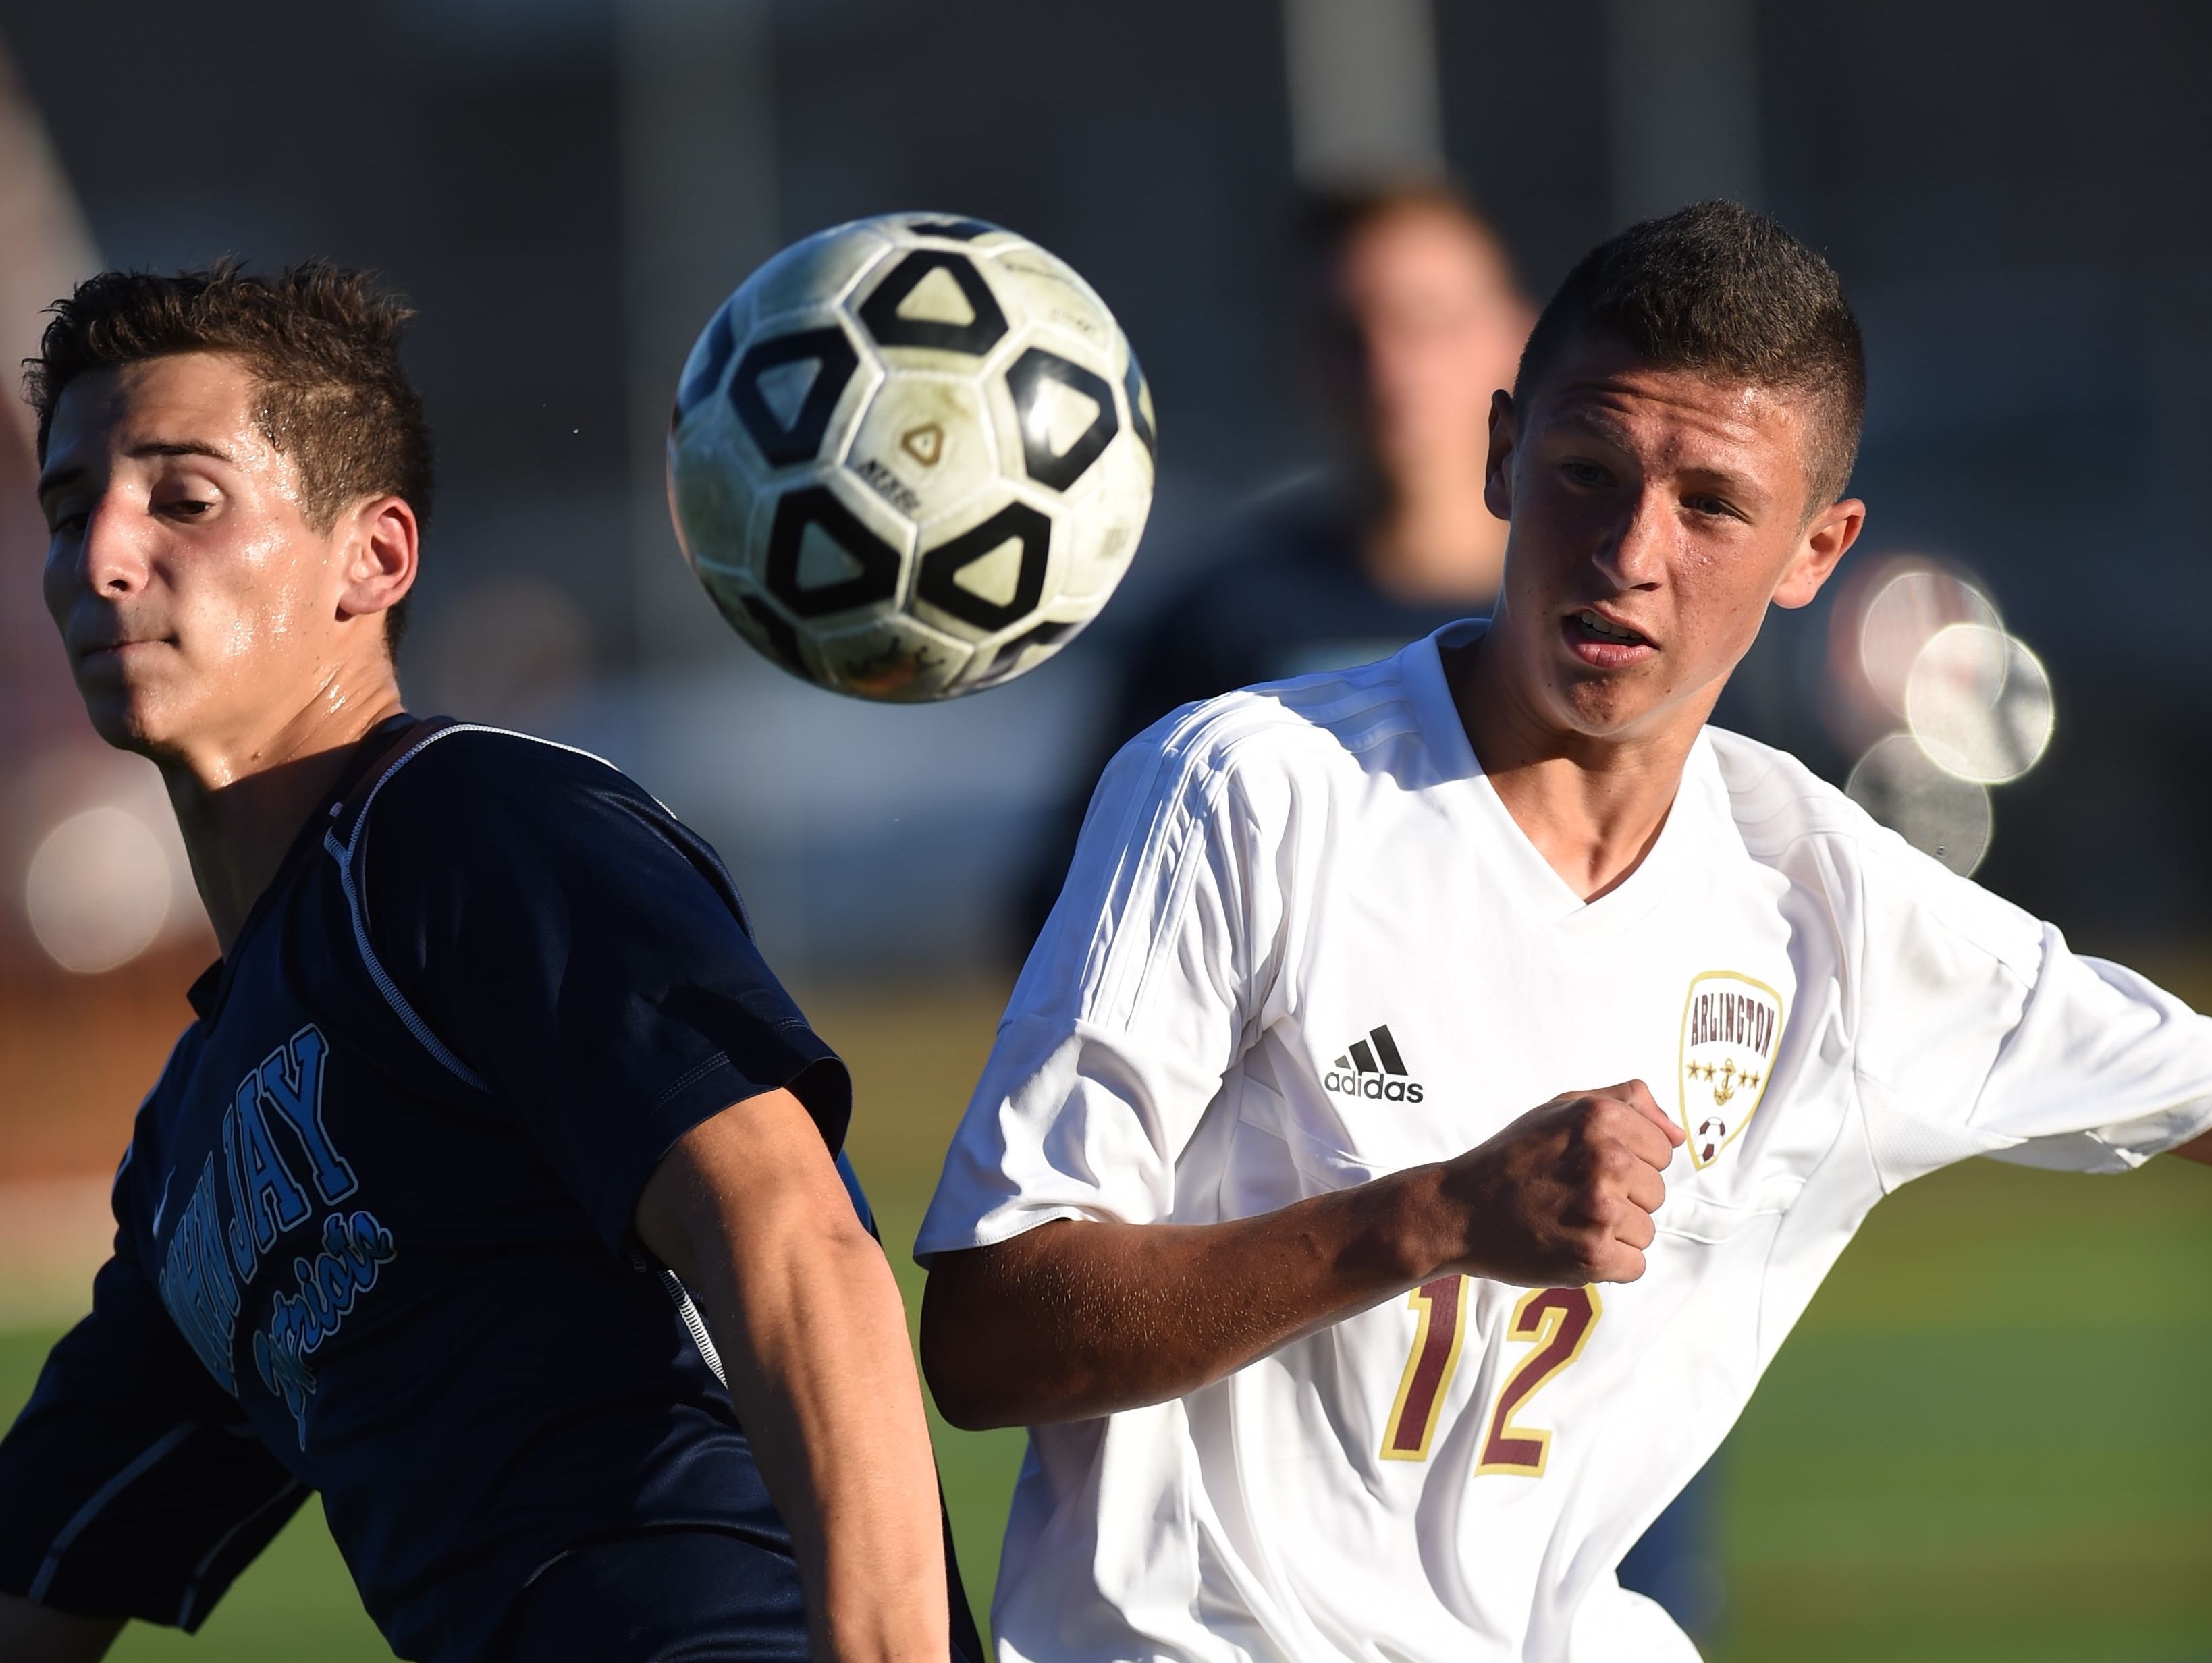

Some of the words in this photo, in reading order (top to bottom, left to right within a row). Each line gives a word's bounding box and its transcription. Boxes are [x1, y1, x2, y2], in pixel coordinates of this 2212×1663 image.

[1324, 1070, 1424, 1103] adidas
[1691, 993, 1775, 1058] ARLINGTON
[222, 1023, 358, 1284] JAY
[1379, 1274, 1604, 1478] 12
